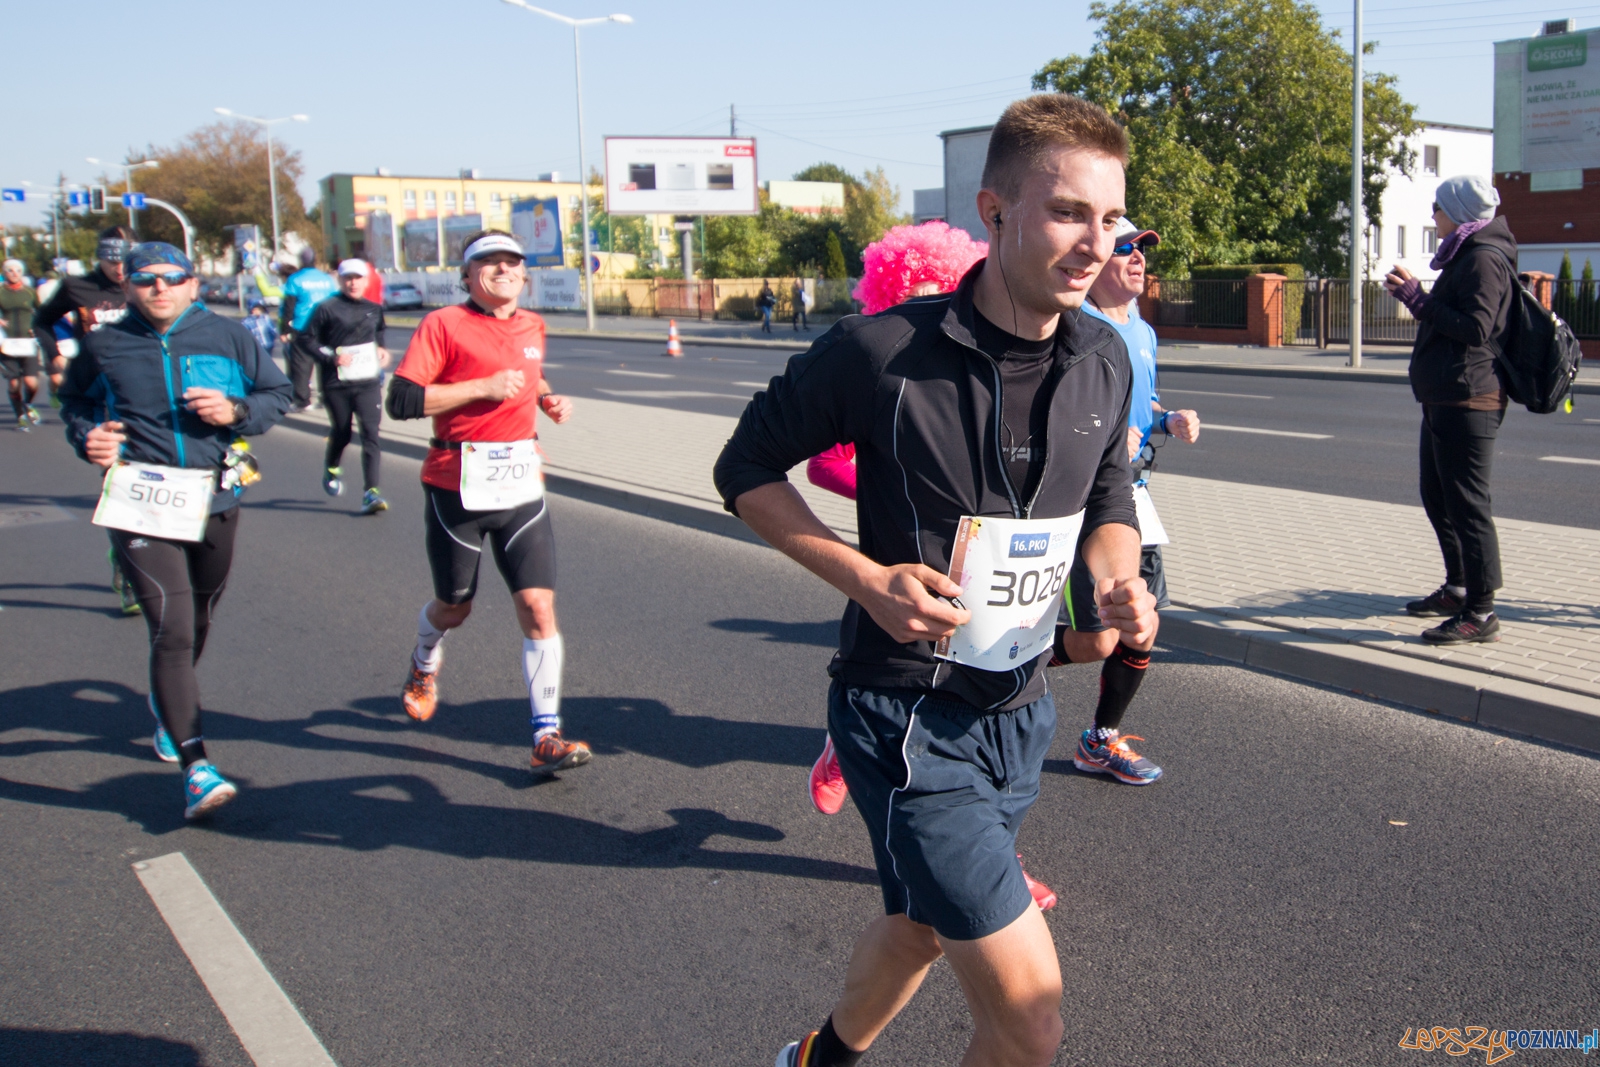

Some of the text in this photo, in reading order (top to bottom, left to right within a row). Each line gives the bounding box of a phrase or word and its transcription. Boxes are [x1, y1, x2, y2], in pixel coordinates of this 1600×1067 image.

[486, 463, 530, 482] 2701
[129, 483, 188, 509] 5106
[987, 561, 1066, 608] 3028
